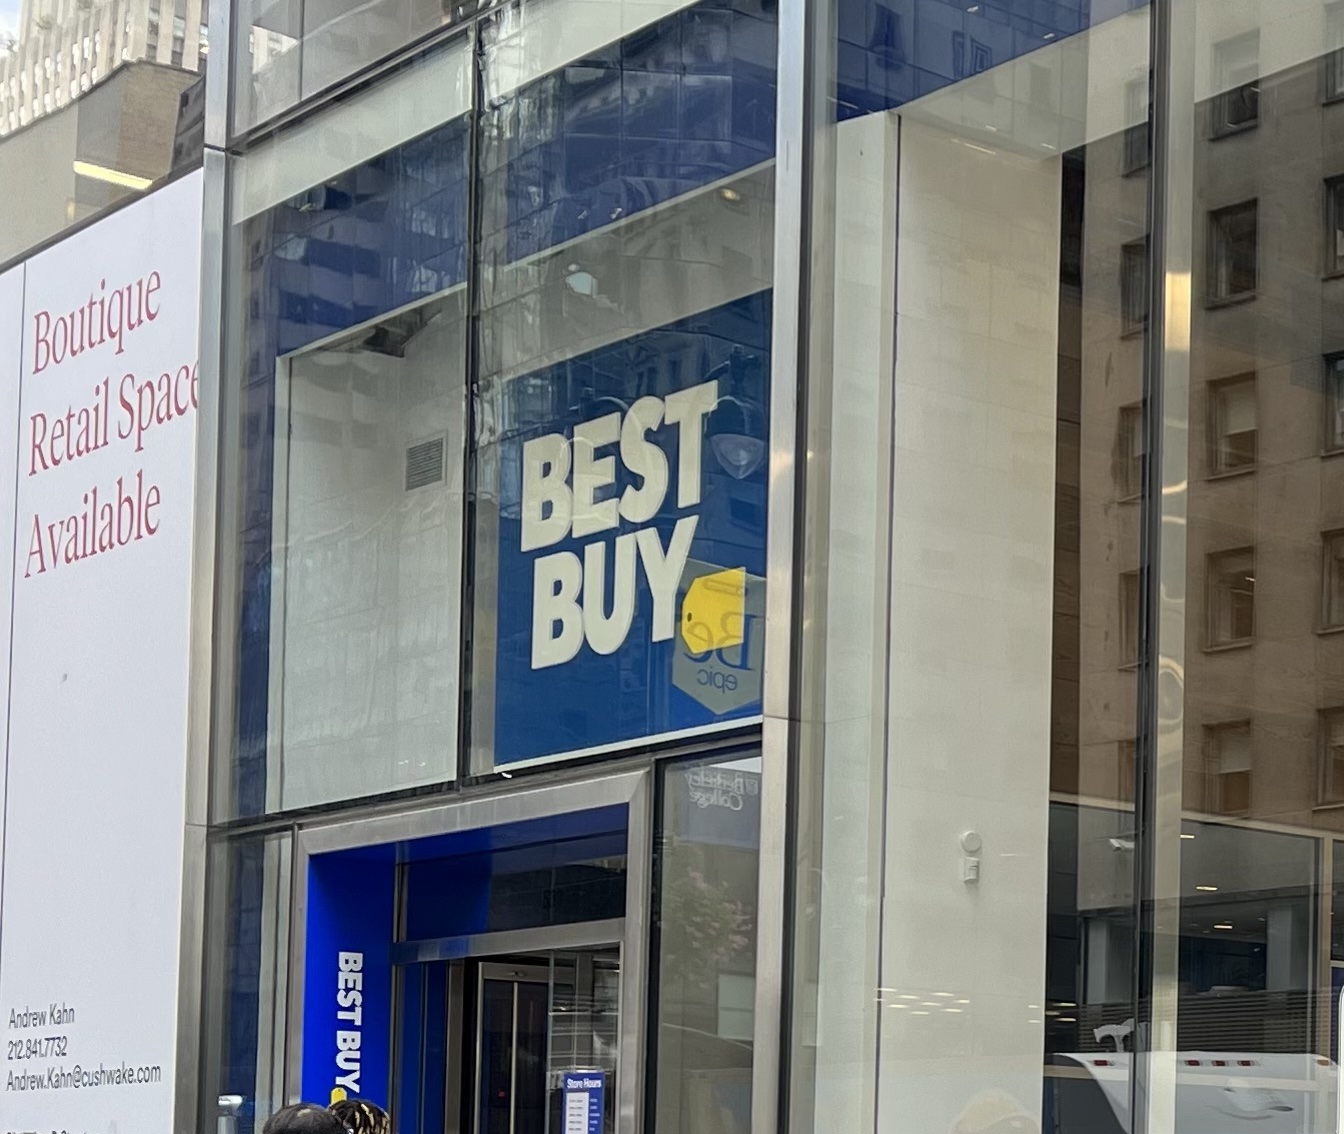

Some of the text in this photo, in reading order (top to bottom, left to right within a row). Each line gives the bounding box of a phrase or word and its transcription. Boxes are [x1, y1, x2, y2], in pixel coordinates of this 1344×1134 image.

[32, 271, 161, 375] Boutique
[28, 377, 109, 476] Retail
[521, 380, 719, 552] BEST
[24, 469, 161, 578] Available
[530, 515, 699, 670] BUY
[7, 1035, 68, 1060] 212.841.7732
[9, 1002, 75, 1029] Andrew Kahn
[335, 952, 363, 1094] BEST BUY
[5, 1061, 161, 1091] Andrew.Kahn@cushwake.com
